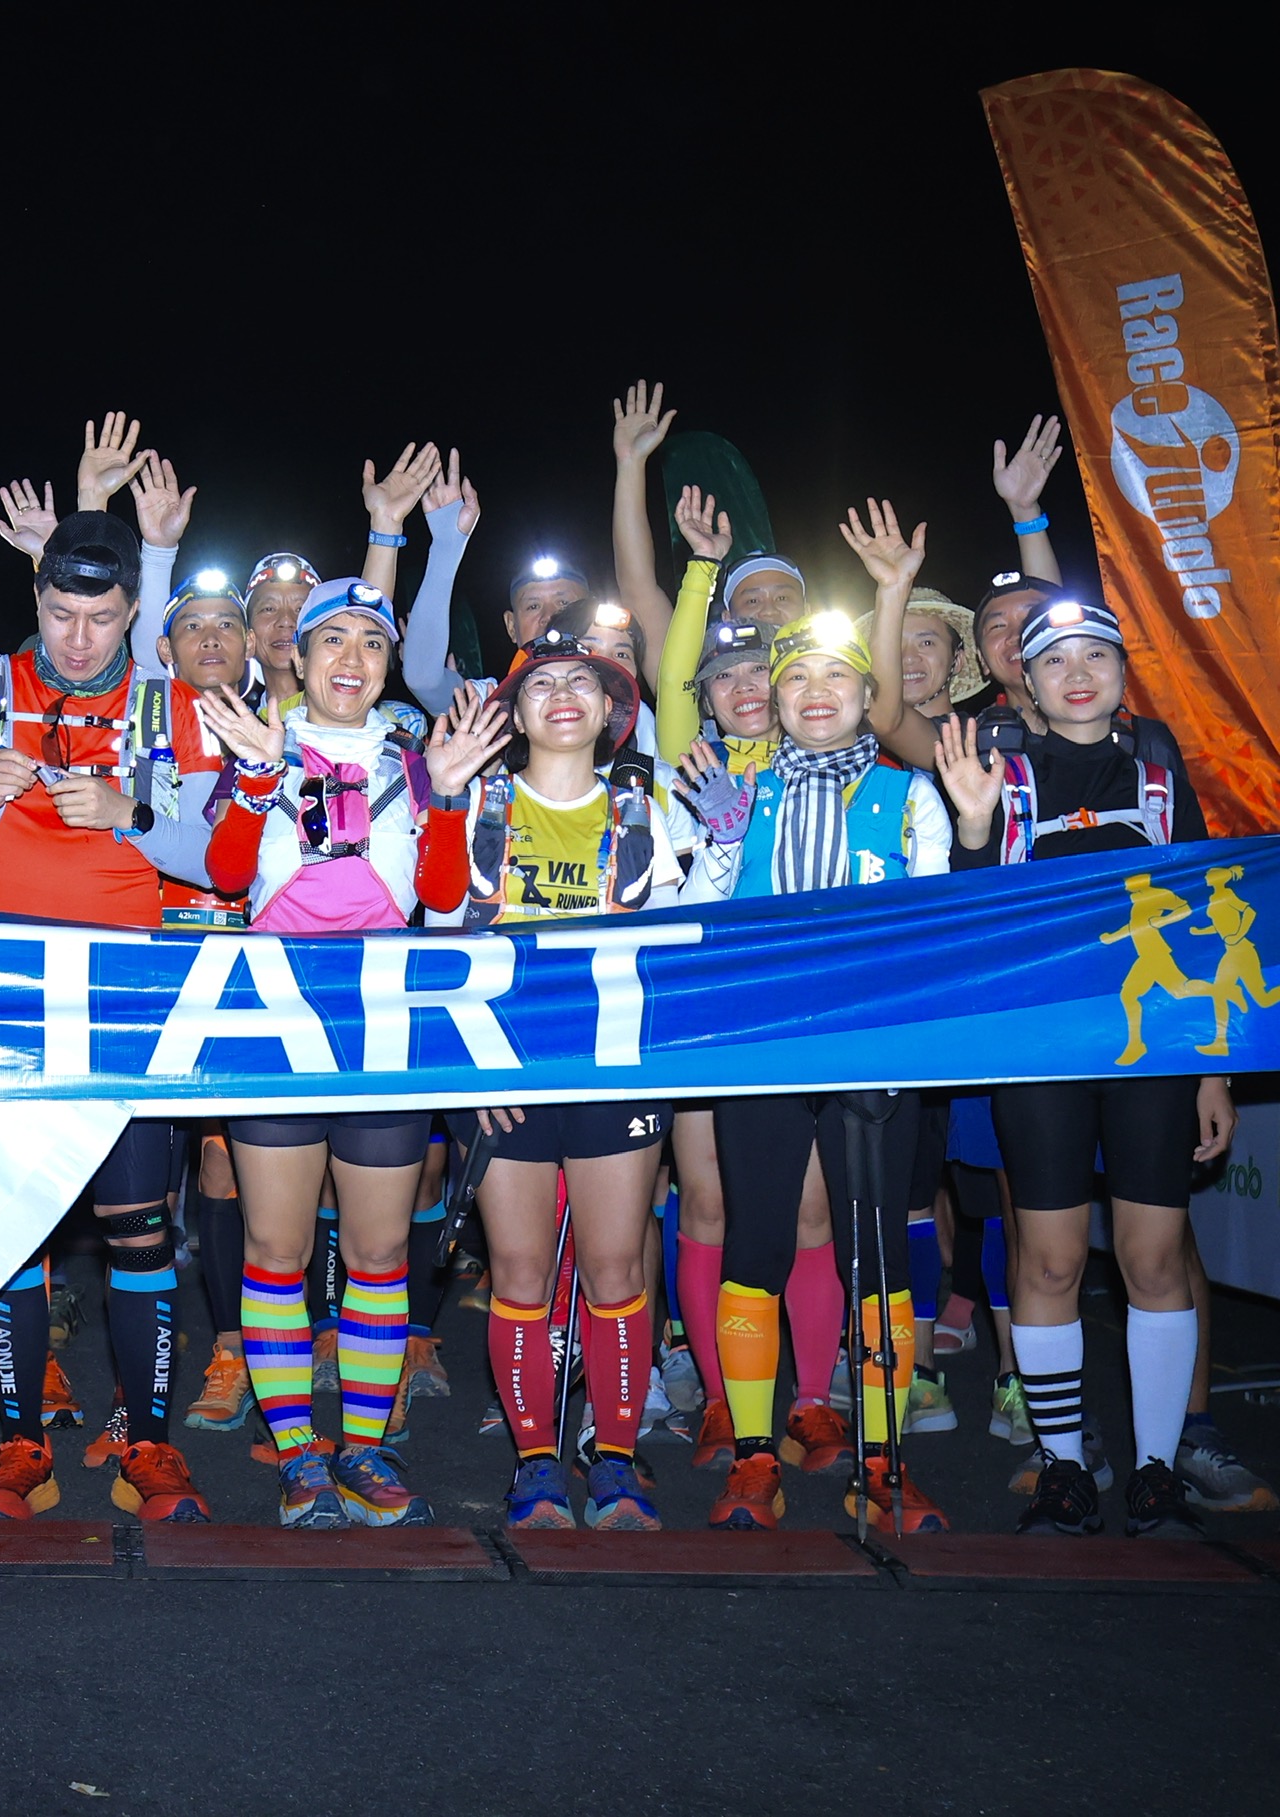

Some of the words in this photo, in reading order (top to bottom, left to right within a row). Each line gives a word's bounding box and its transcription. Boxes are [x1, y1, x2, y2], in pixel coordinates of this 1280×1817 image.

[1116, 273, 1186, 417] Race
[151, 690, 162, 733] AONIJIE
[548, 860, 589, 887] VKL
[178, 911, 201, 921] 42km
[325, 1249, 337, 1301] AONIJIE
[153, 1326, 172, 1394] AONIJIE
[511, 1326, 526, 1412] COMPRESSPORT
[617, 1317, 630, 1402] COMPRESSPORT
